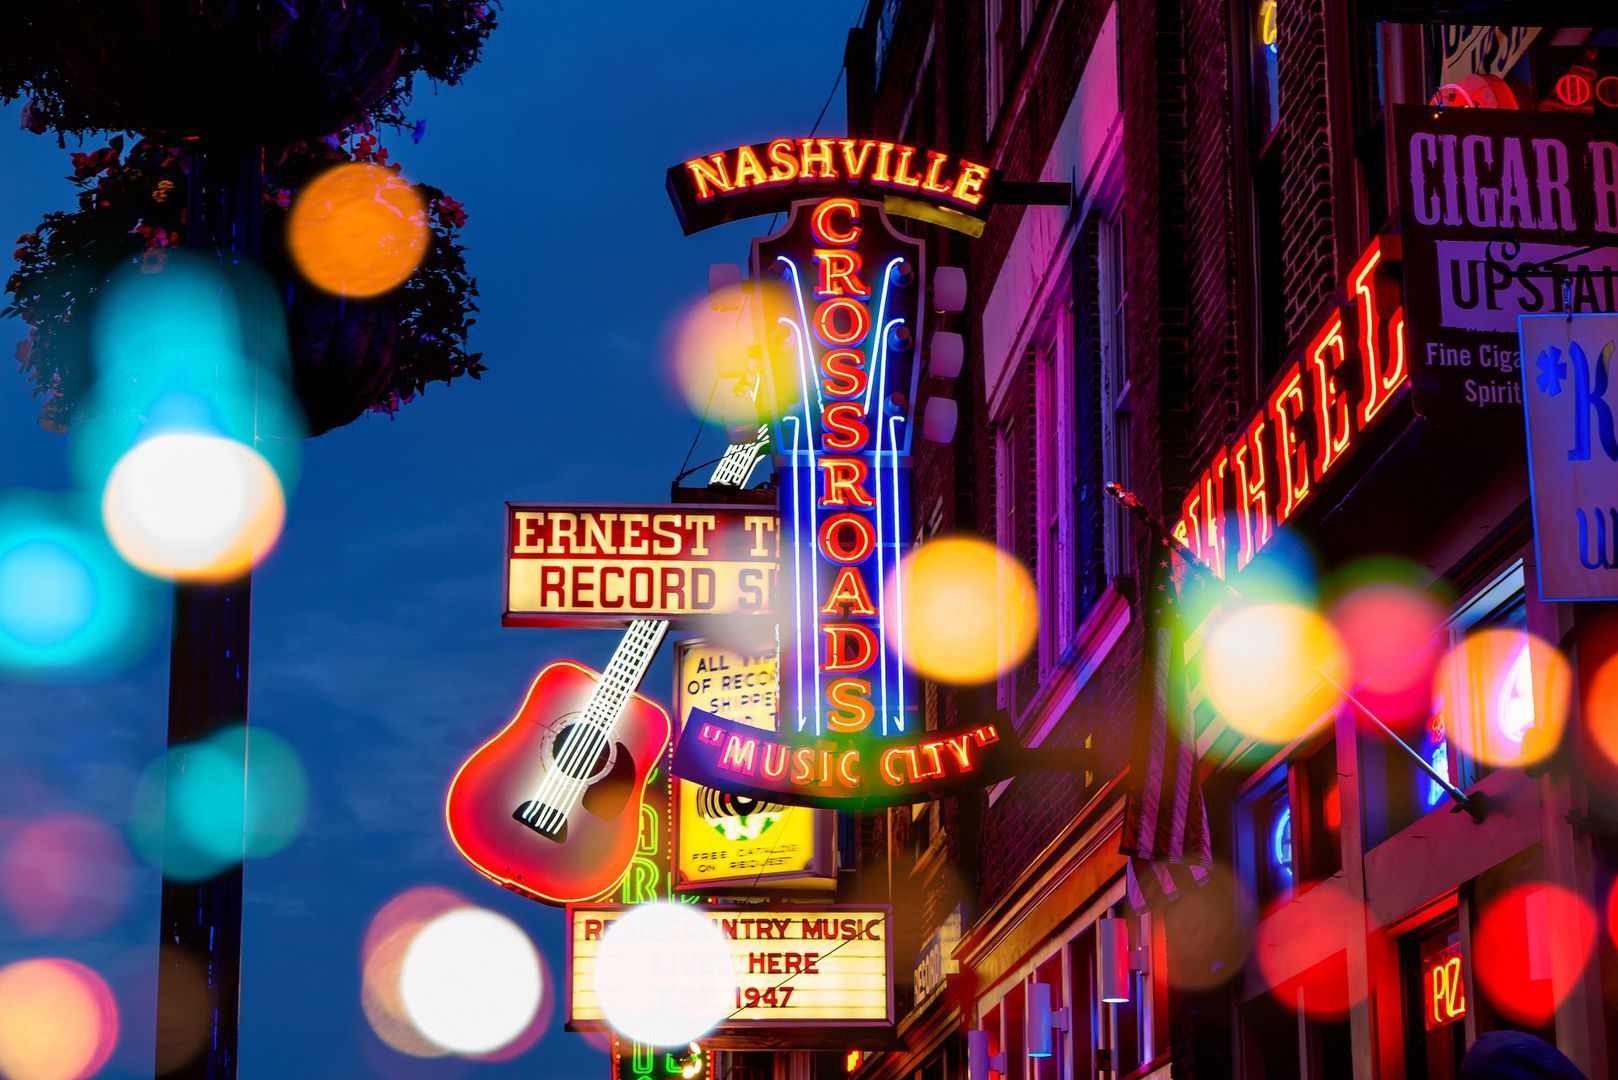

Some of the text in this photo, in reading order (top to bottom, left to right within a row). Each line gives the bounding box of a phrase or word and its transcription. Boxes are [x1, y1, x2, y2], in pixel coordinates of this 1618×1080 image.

[684, 138, 990, 206] NASHVILLE
[1410, 132, 1577, 231] CIGAR
[1426, 343, 1471, 367] Fine
[811, 197, 880, 733] CROSSROADS
[514, 512, 715, 556] ERNEST
[541, 565, 716, 610] RECORD
[697, 655, 730, 673] ALL
[687, 678, 711, 695] OF
[692, 851, 727, 861] FREE
[802, 918, 881, 941] MUSIC
[749, 952, 820, 975] HERE
[735, 986, 795, 1009] 1947
